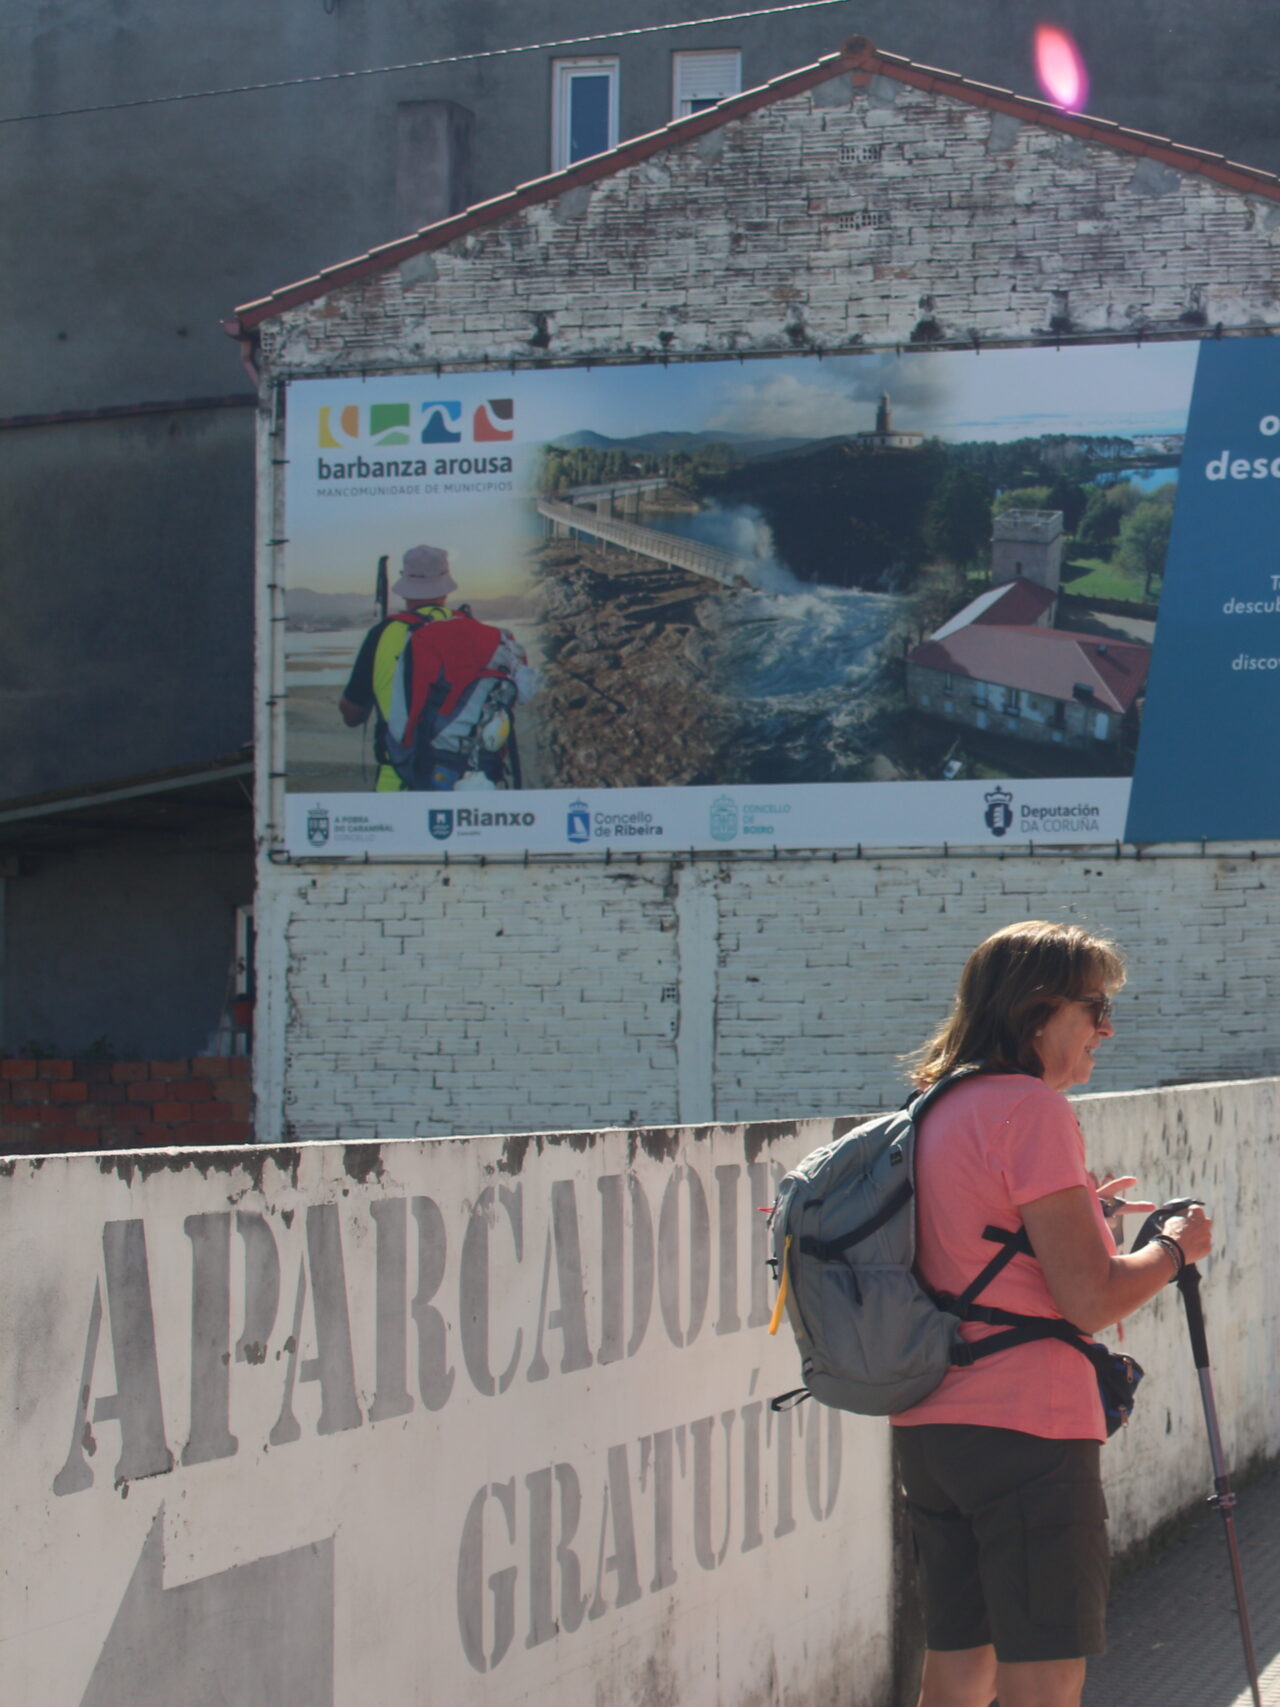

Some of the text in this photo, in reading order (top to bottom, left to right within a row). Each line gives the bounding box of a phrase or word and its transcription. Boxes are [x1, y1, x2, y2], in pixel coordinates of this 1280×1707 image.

[1259, 414, 1280, 436] o
[317, 456, 513, 480] barbanza arousa
[317, 481, 513, 498] MANCOMUNIDADE DE MUNICIPIOS
[456, 808, 536, 827] Rianxo
[594, 811, 653, 825] Concello
[1020, 803, 1100, 820] Deputación
[594, 824, 664, 837] de Ribeira
[1020, 817, 1100, 833] DA CORUÑA
[457, 1368, 843, 1675] GRATUÍTO
